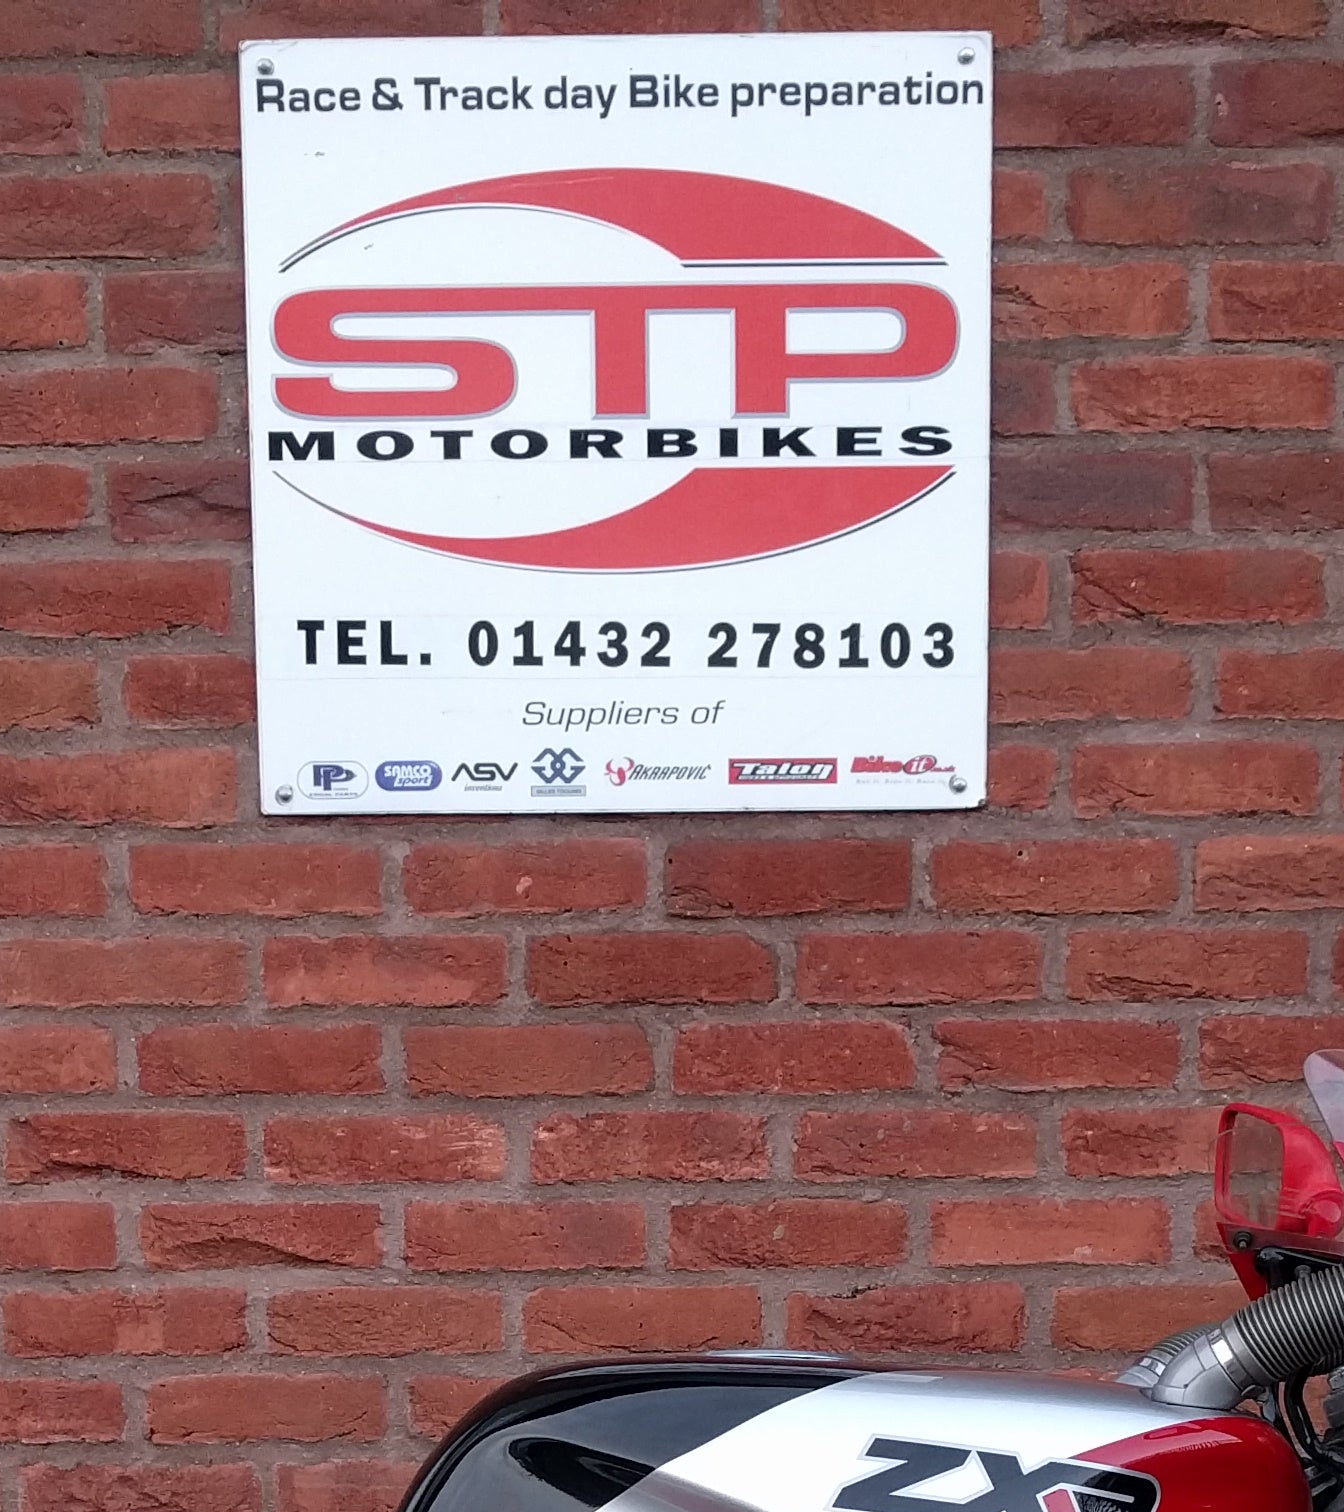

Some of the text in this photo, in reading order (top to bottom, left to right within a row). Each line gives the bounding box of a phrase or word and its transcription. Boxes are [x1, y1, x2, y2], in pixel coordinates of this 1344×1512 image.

[256, 70, 984, 119] Race & Track day Bike preparation
[270, 280, 961, 422] STP
[267, 425, 953, 461] MOTORBIKES
[297, 619, 956, 668] TEL. 01432 278103
[522, 699, 725, 732] Suppliers of
[451, 762, 518, 782] ASV
[732, 761, 834, 782] Talon
